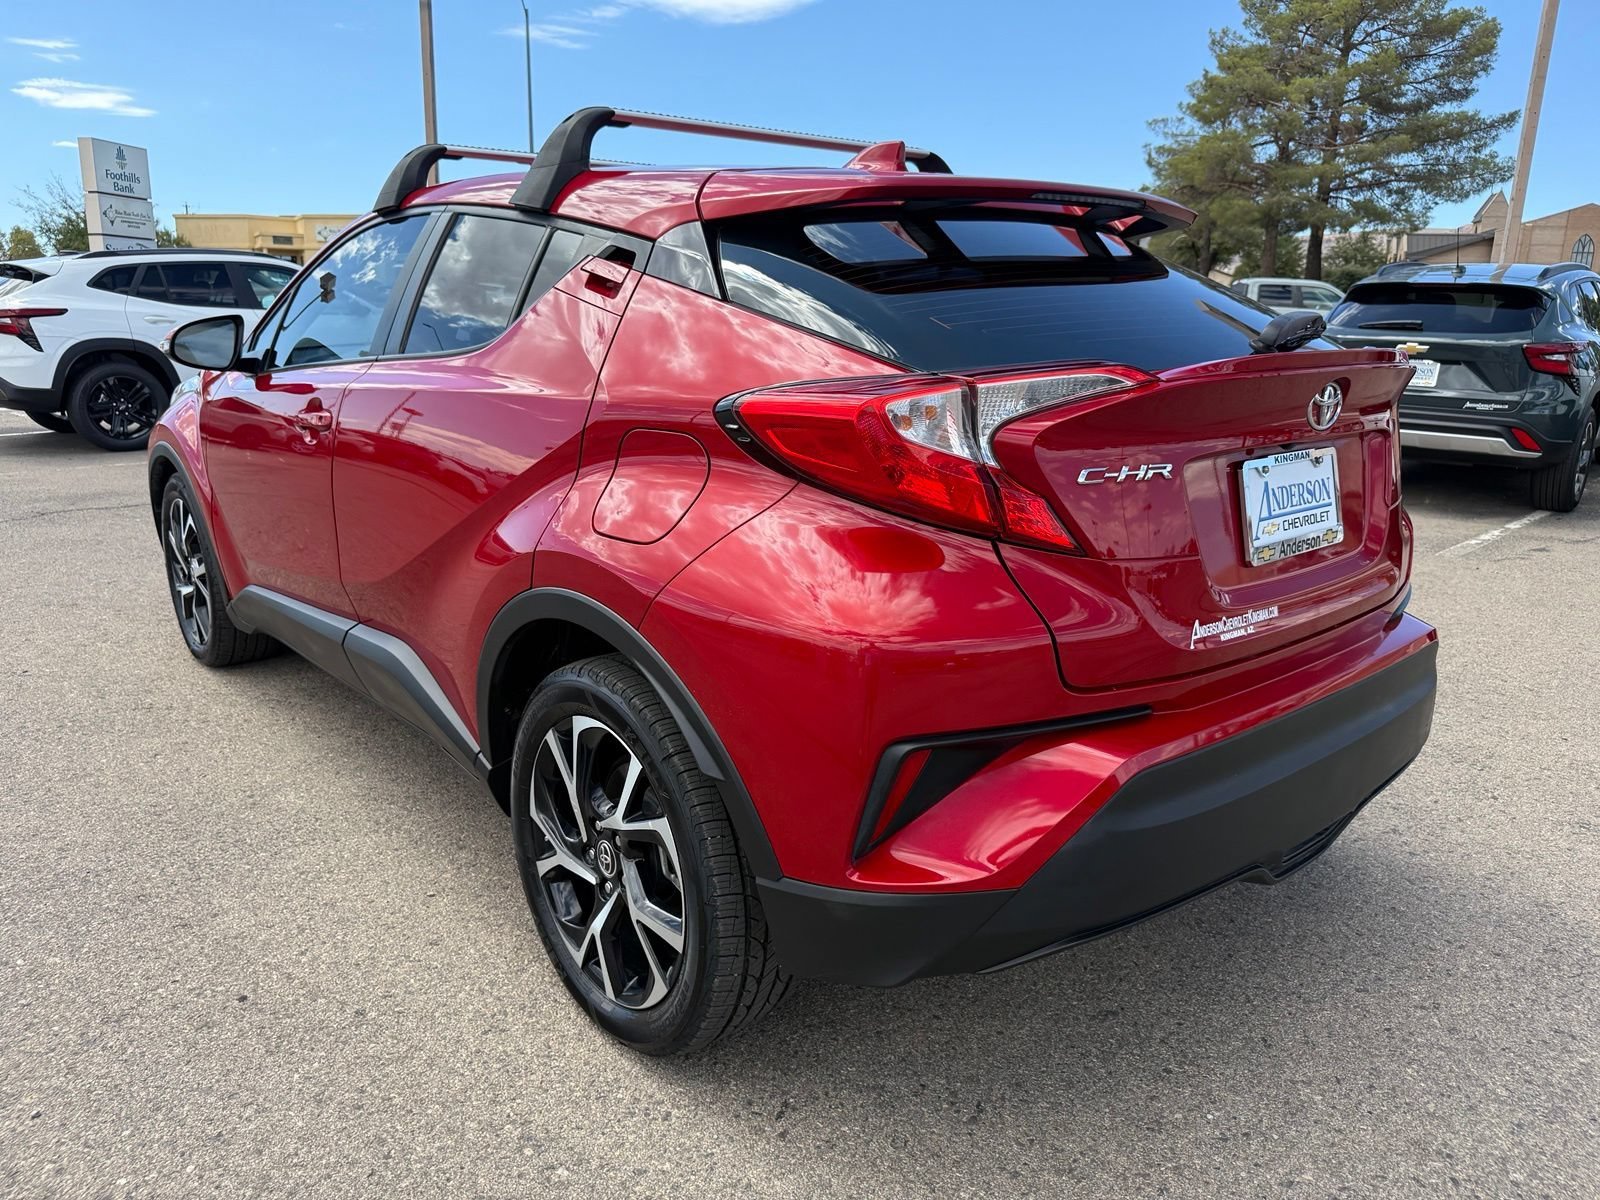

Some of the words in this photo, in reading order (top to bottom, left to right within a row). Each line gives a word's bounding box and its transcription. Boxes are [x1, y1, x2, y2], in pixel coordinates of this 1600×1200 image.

[105, 169, 141, 184] Foothills
[113, 182, 135, 194] Bank
[1274, 451, 1310, 464] KINGMAN
[1077, 463, 1173, 484] C-HR
[1253, 476, 1332, 540] ANDERSON
[1282, 510, 1330, 531] CHEVROLET
[1278, 535, 1321, 558] Anderson
